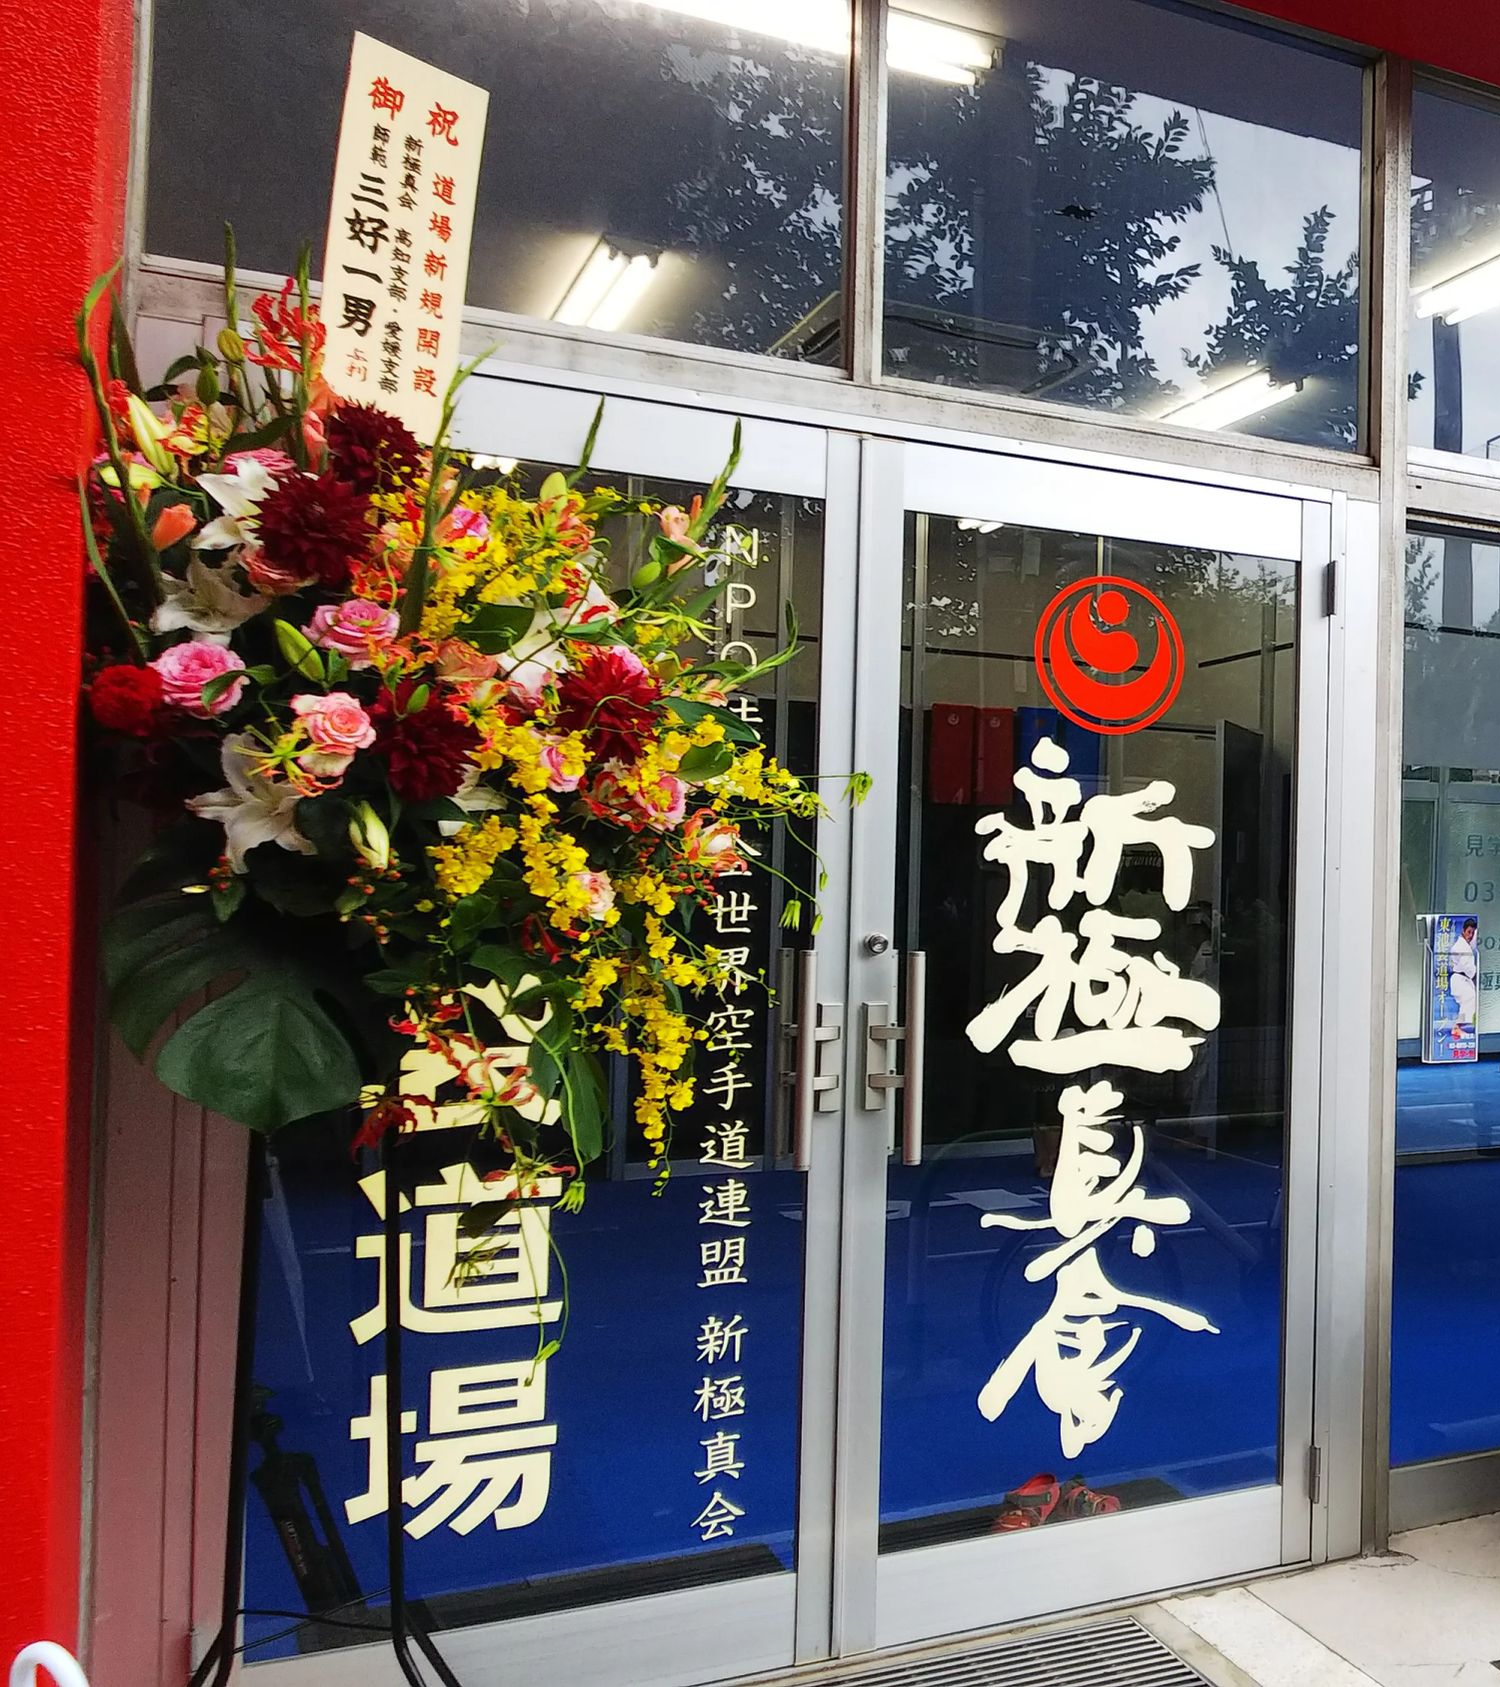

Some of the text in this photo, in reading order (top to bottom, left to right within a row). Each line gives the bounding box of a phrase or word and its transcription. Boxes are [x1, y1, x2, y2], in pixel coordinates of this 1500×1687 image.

[336, 171, 390, 338] 三好一男
[397, 134, 425, 212] 新極真会
[412, 173, 456, 398] 道場新規開設
[692, 1313, 748, 1542] 新極真会
